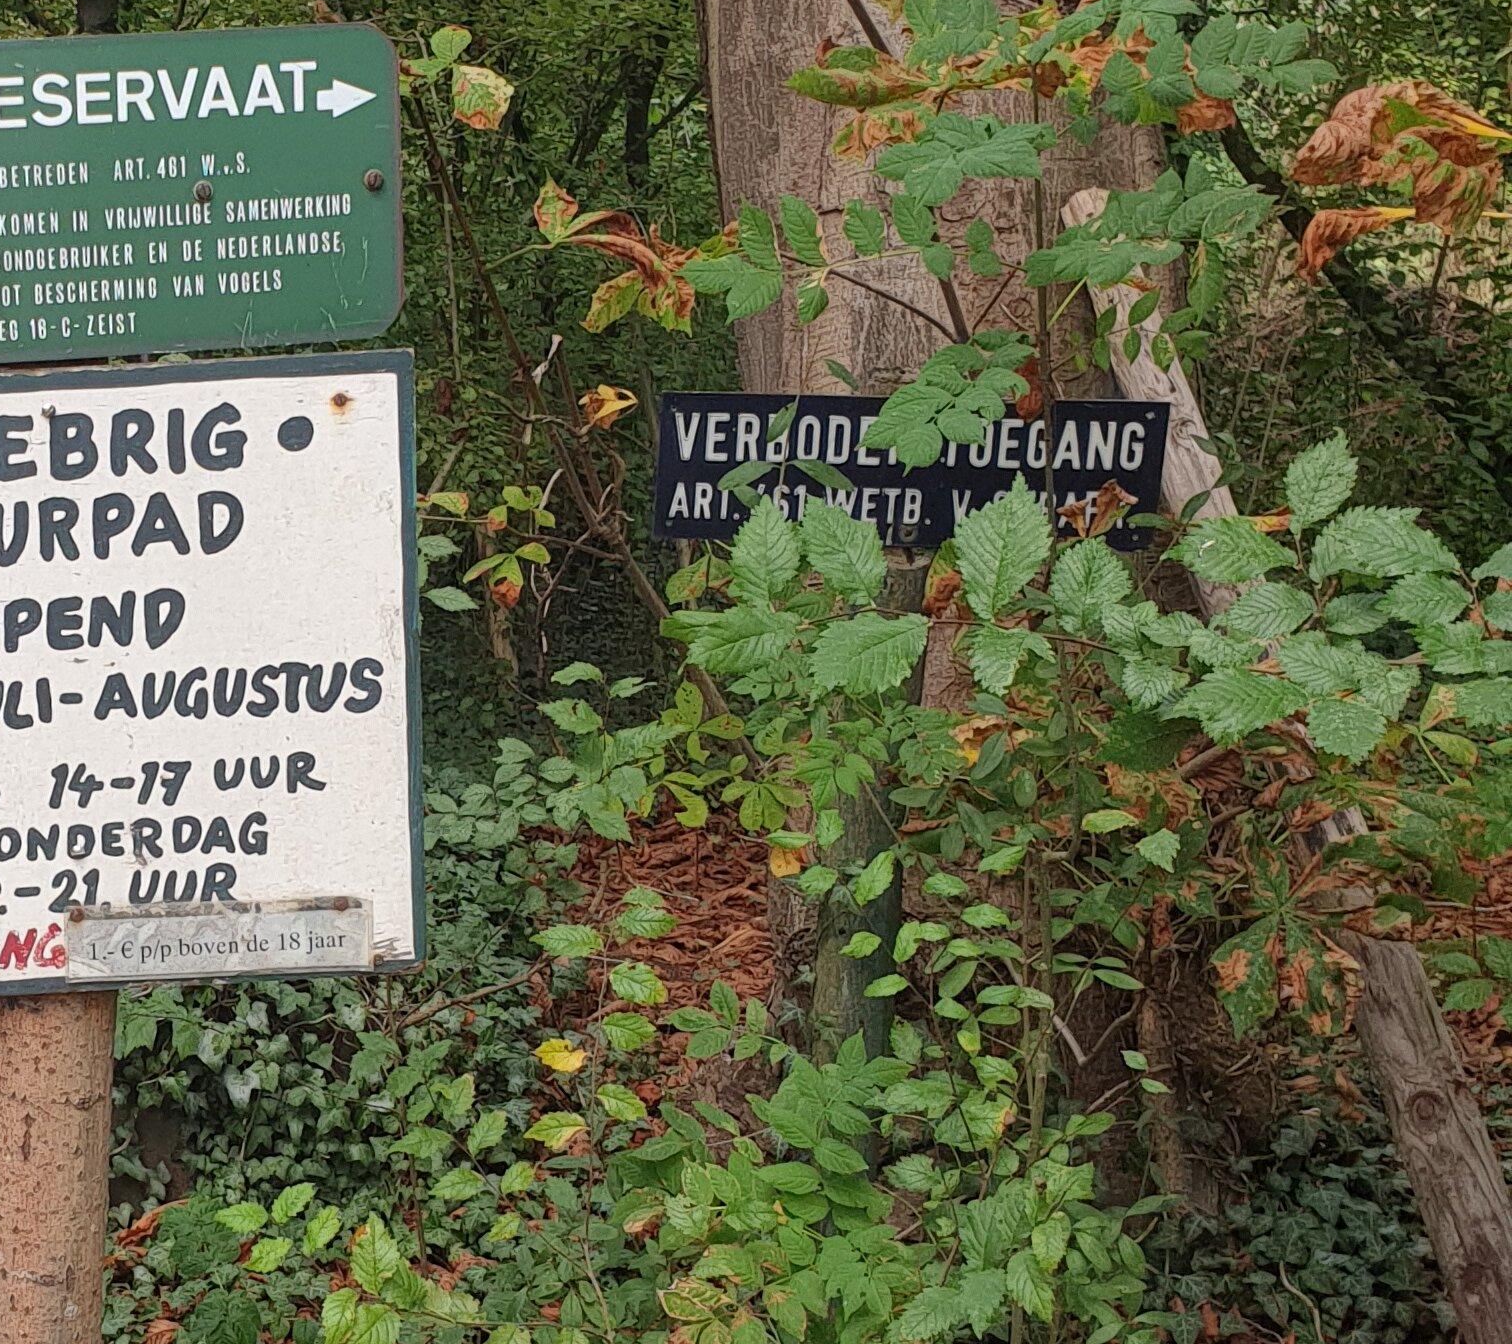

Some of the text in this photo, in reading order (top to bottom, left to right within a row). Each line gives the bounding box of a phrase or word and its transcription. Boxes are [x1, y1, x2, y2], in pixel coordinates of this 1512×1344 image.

[73, 210, 88, 232] IN
[105, 202, 212, 230] VRIJWILLIGE
[226, 194, 351, 223] SAMENWERKING
[149, 240, 167, 264] EN
[182, 239, 202, 262] DE
[217, 231, 341, 260] NEDERLANDSE
[34, 277, 157, 305] BESCHERMING
[173, 274, 204, 297] VAN
[218, 269, 282, 294] VOGELS
[48, 760, 192, 810] 14-17
[214, 751, 327, 794] UUR
[128, 862, 242, 906] UUR
[121, 941, 135, 958] €
[140, 939, 172, 964] p/p
[178, 938, 239, 957] boven
[246, 934, 269, 952] de
[278, 933, 301, 951] 18
[306, 931, 346, 955] jaar
